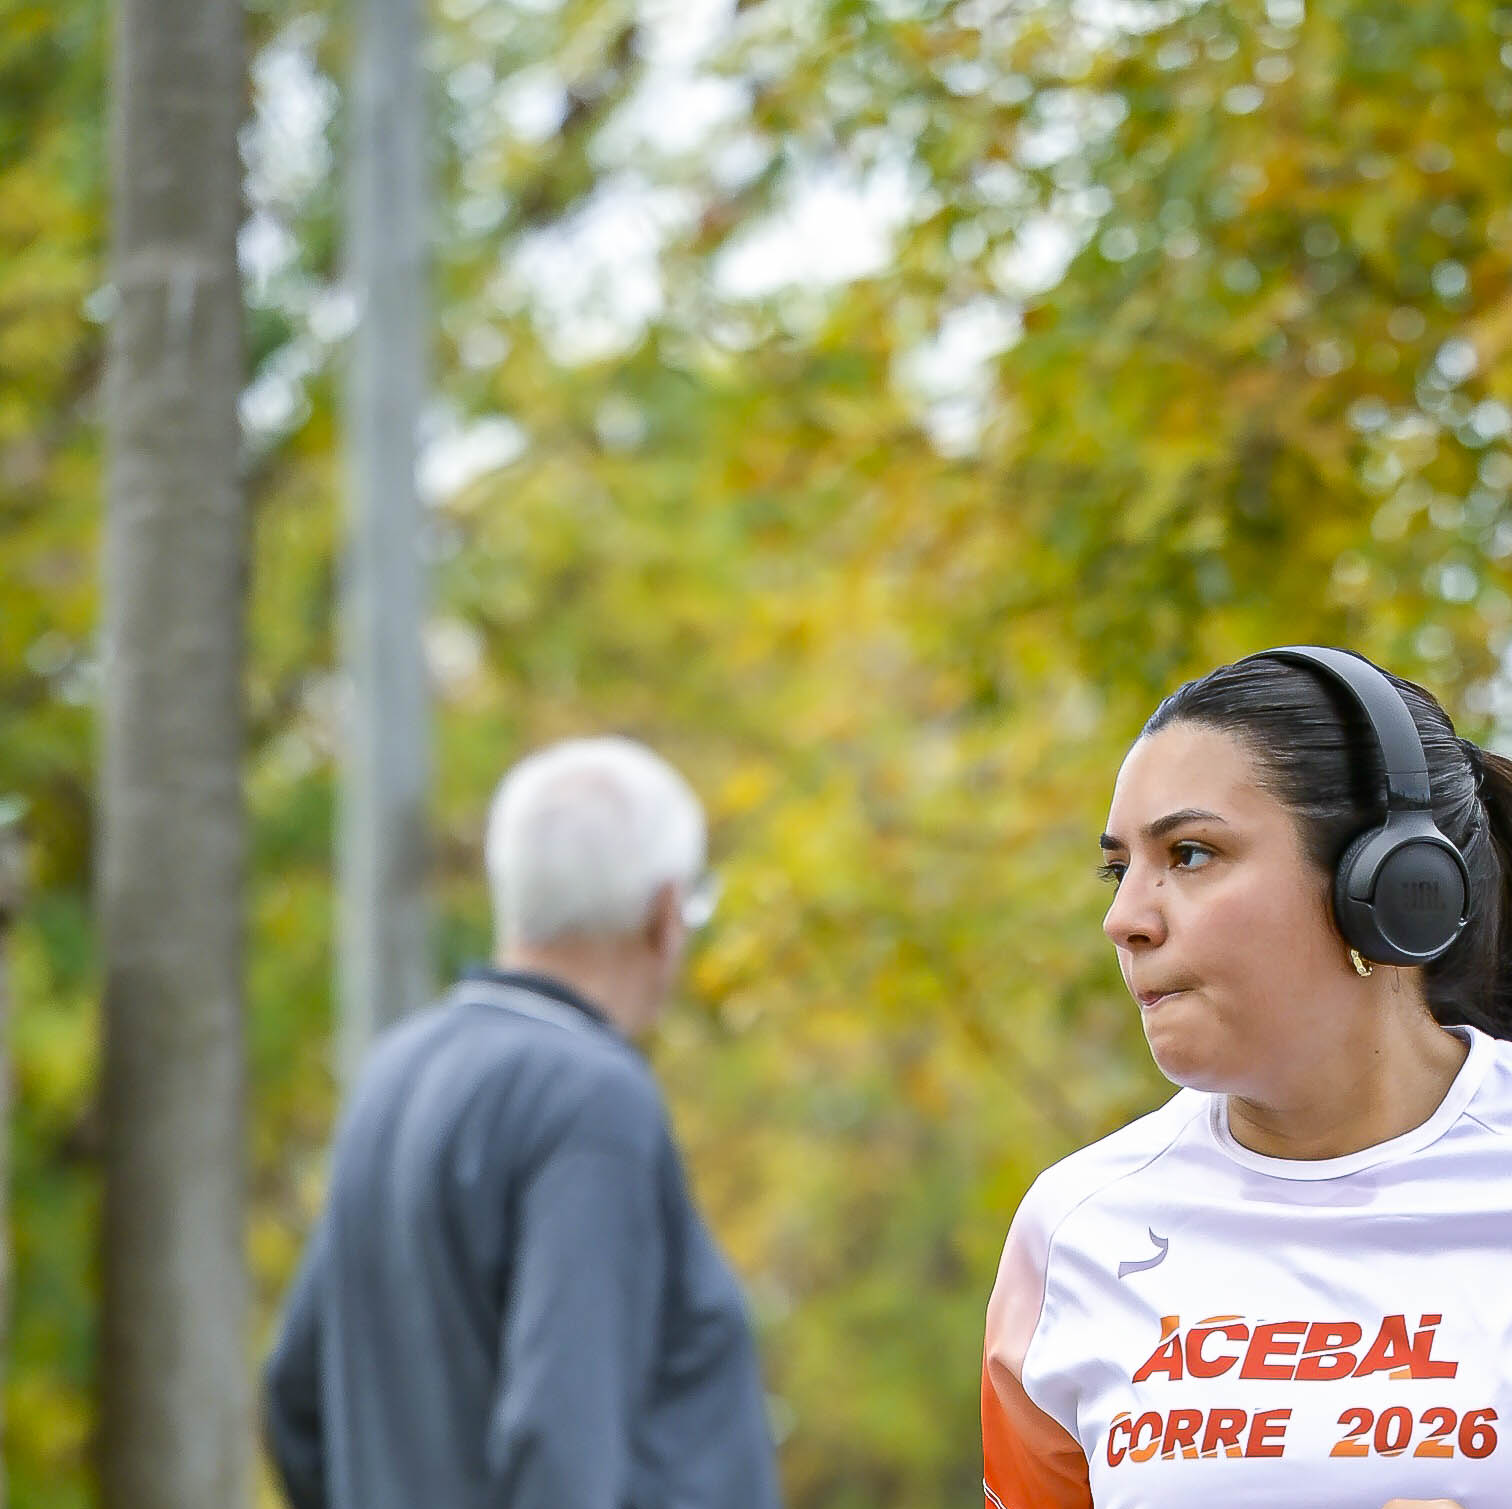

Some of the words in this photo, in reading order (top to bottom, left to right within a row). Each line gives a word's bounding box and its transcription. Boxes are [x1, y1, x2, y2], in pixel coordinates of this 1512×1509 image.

[1132, 1314, 1459, 1384] ACEBAL
[1106, 1407, 1293, 1468] CORRE
[1328, 1406, 1498, 1460] 2026
